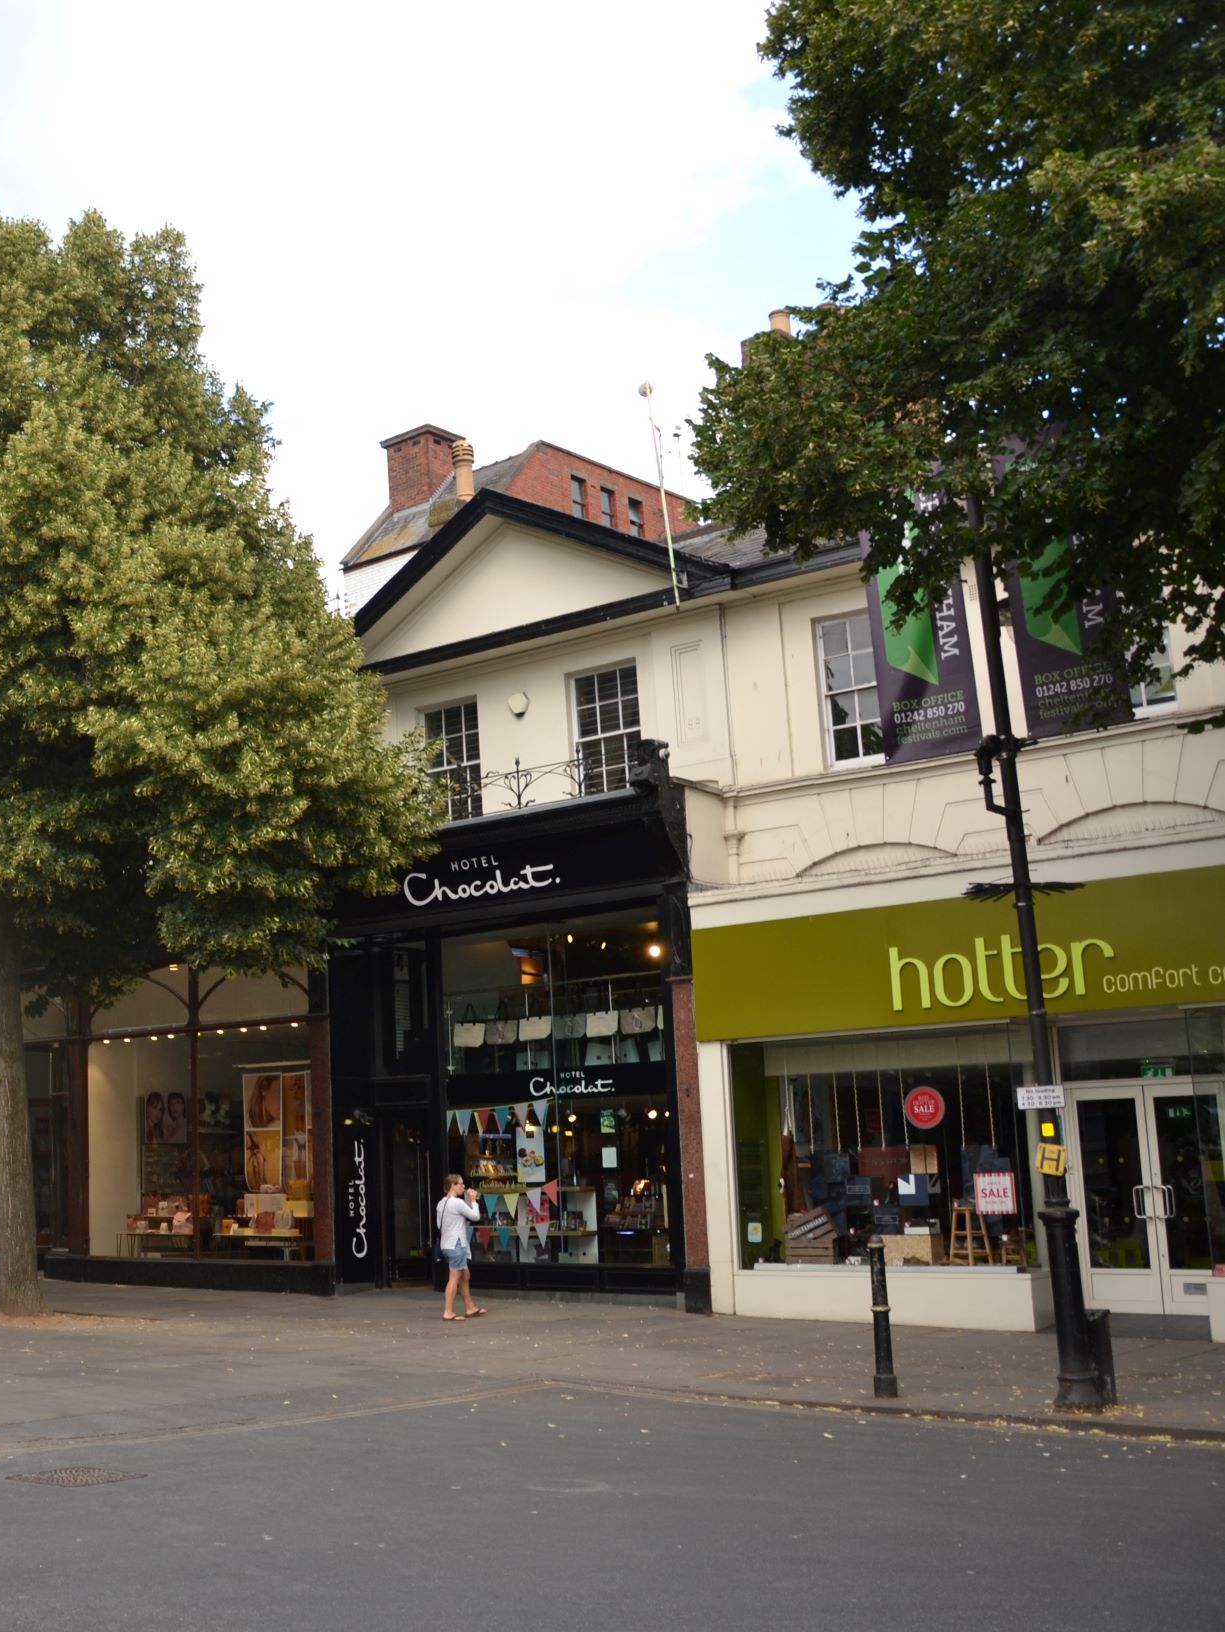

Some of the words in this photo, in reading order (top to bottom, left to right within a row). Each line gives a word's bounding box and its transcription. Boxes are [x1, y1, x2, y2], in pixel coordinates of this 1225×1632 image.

[1034, 670, 1061, 685] BOX
[1036, 681, 1068, 697] 01242
[1070, 676, 1090, 691] 850
[1093, 672, 1113, 687] 270
[892, 699, 919, 712] BOX
[921, 690, 964, 707] OFFICE
[894, 710, 925, 724] 01242
[926, 705, 945, 719] 850
[947, 701, 965, 715] 270
[896, 715, 966, 735] cheltenham
[897, 725, 968, 745] festivals.com
[450, 855, 499, 872] HOTEL
[888, 934, 1115, 1012] hotter
[1103, 963, 1201, 994] comfort
[560, 1071, 585, 1079] HOTEL
[913, 1105, 935, 1113] SALE
[1040, 1146, 1061, 1172] H
[981, 1187, 1009, 1198] SALE
